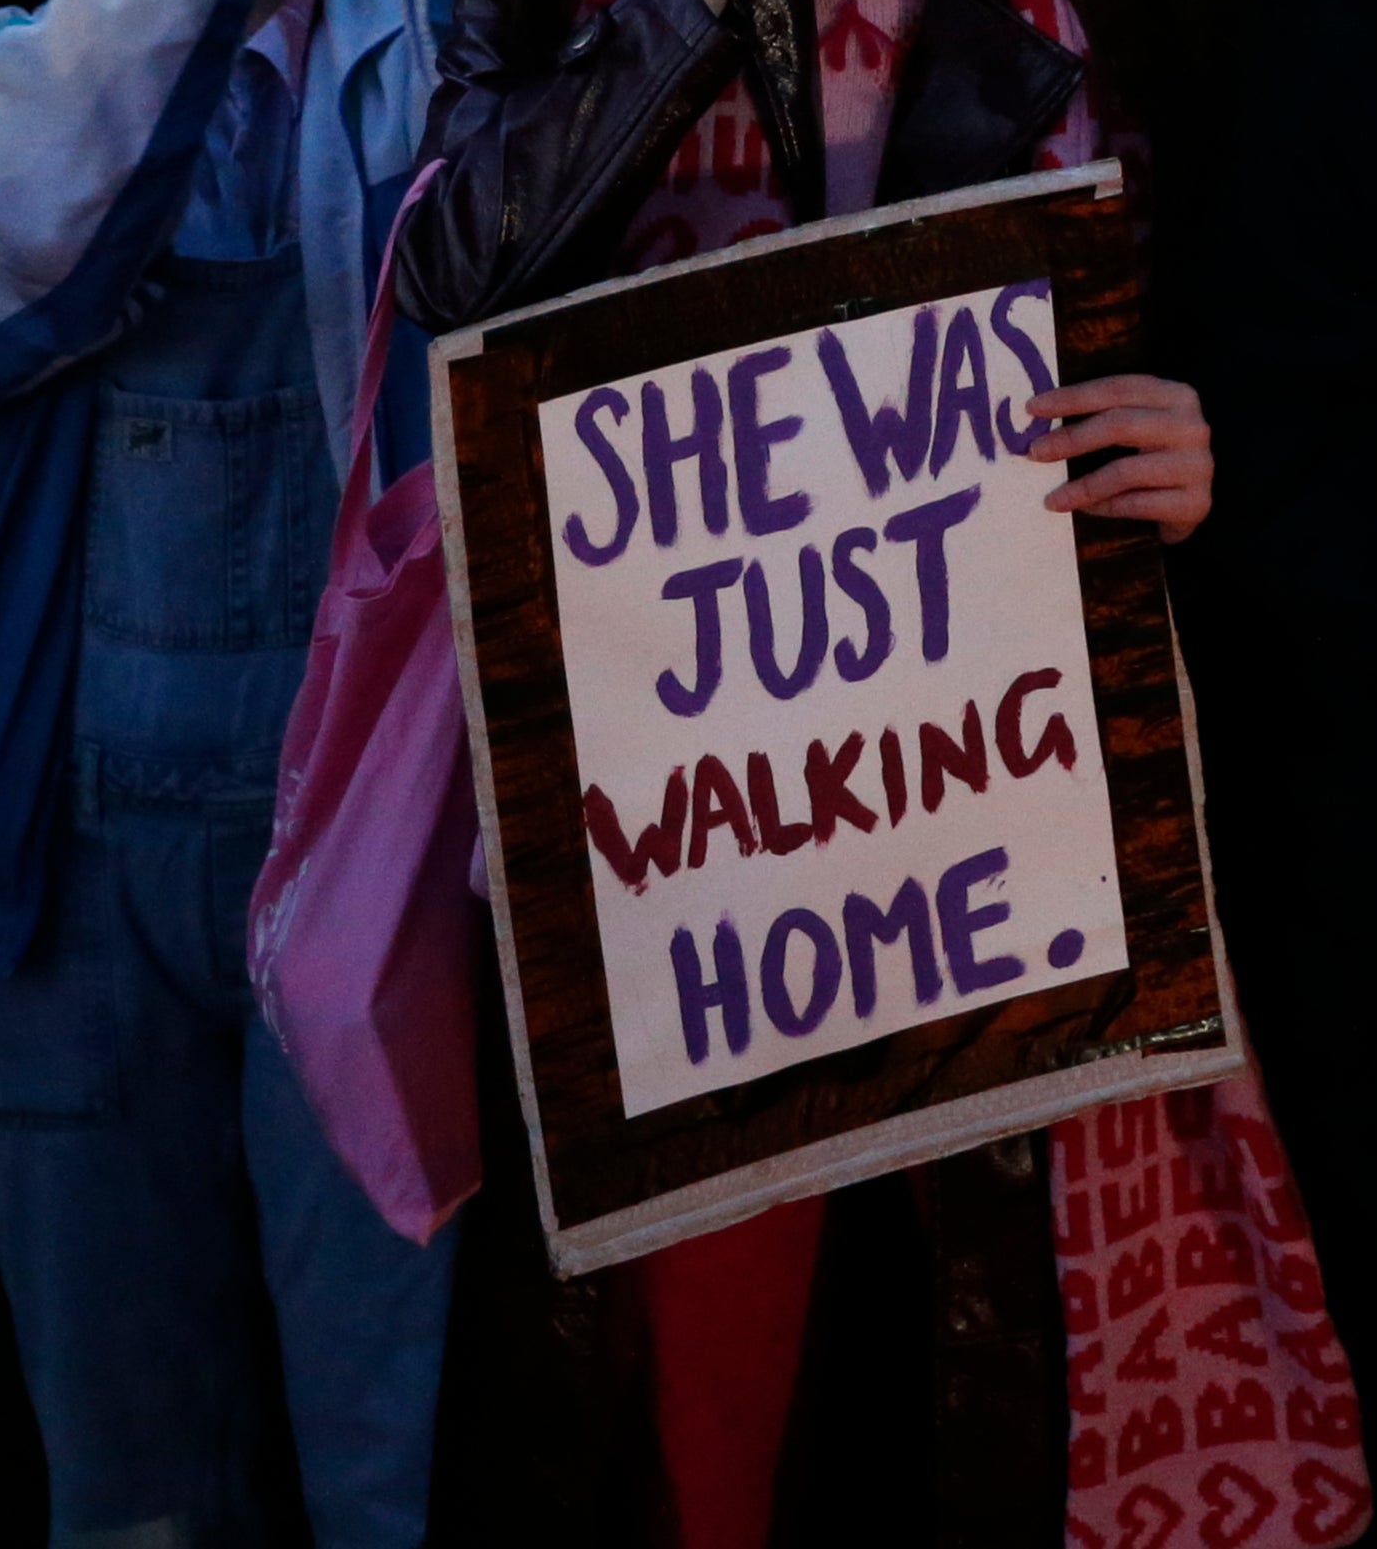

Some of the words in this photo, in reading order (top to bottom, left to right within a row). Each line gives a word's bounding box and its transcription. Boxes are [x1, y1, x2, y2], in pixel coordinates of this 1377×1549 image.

[562, 344, 812, 568] SHE
[817, 275, 1057, 499] WAS
[655, 485, 982, 719] JUST
[583, 666, 1076, 896] WALKING
[668, 845, 1085, 1068] HOME.
